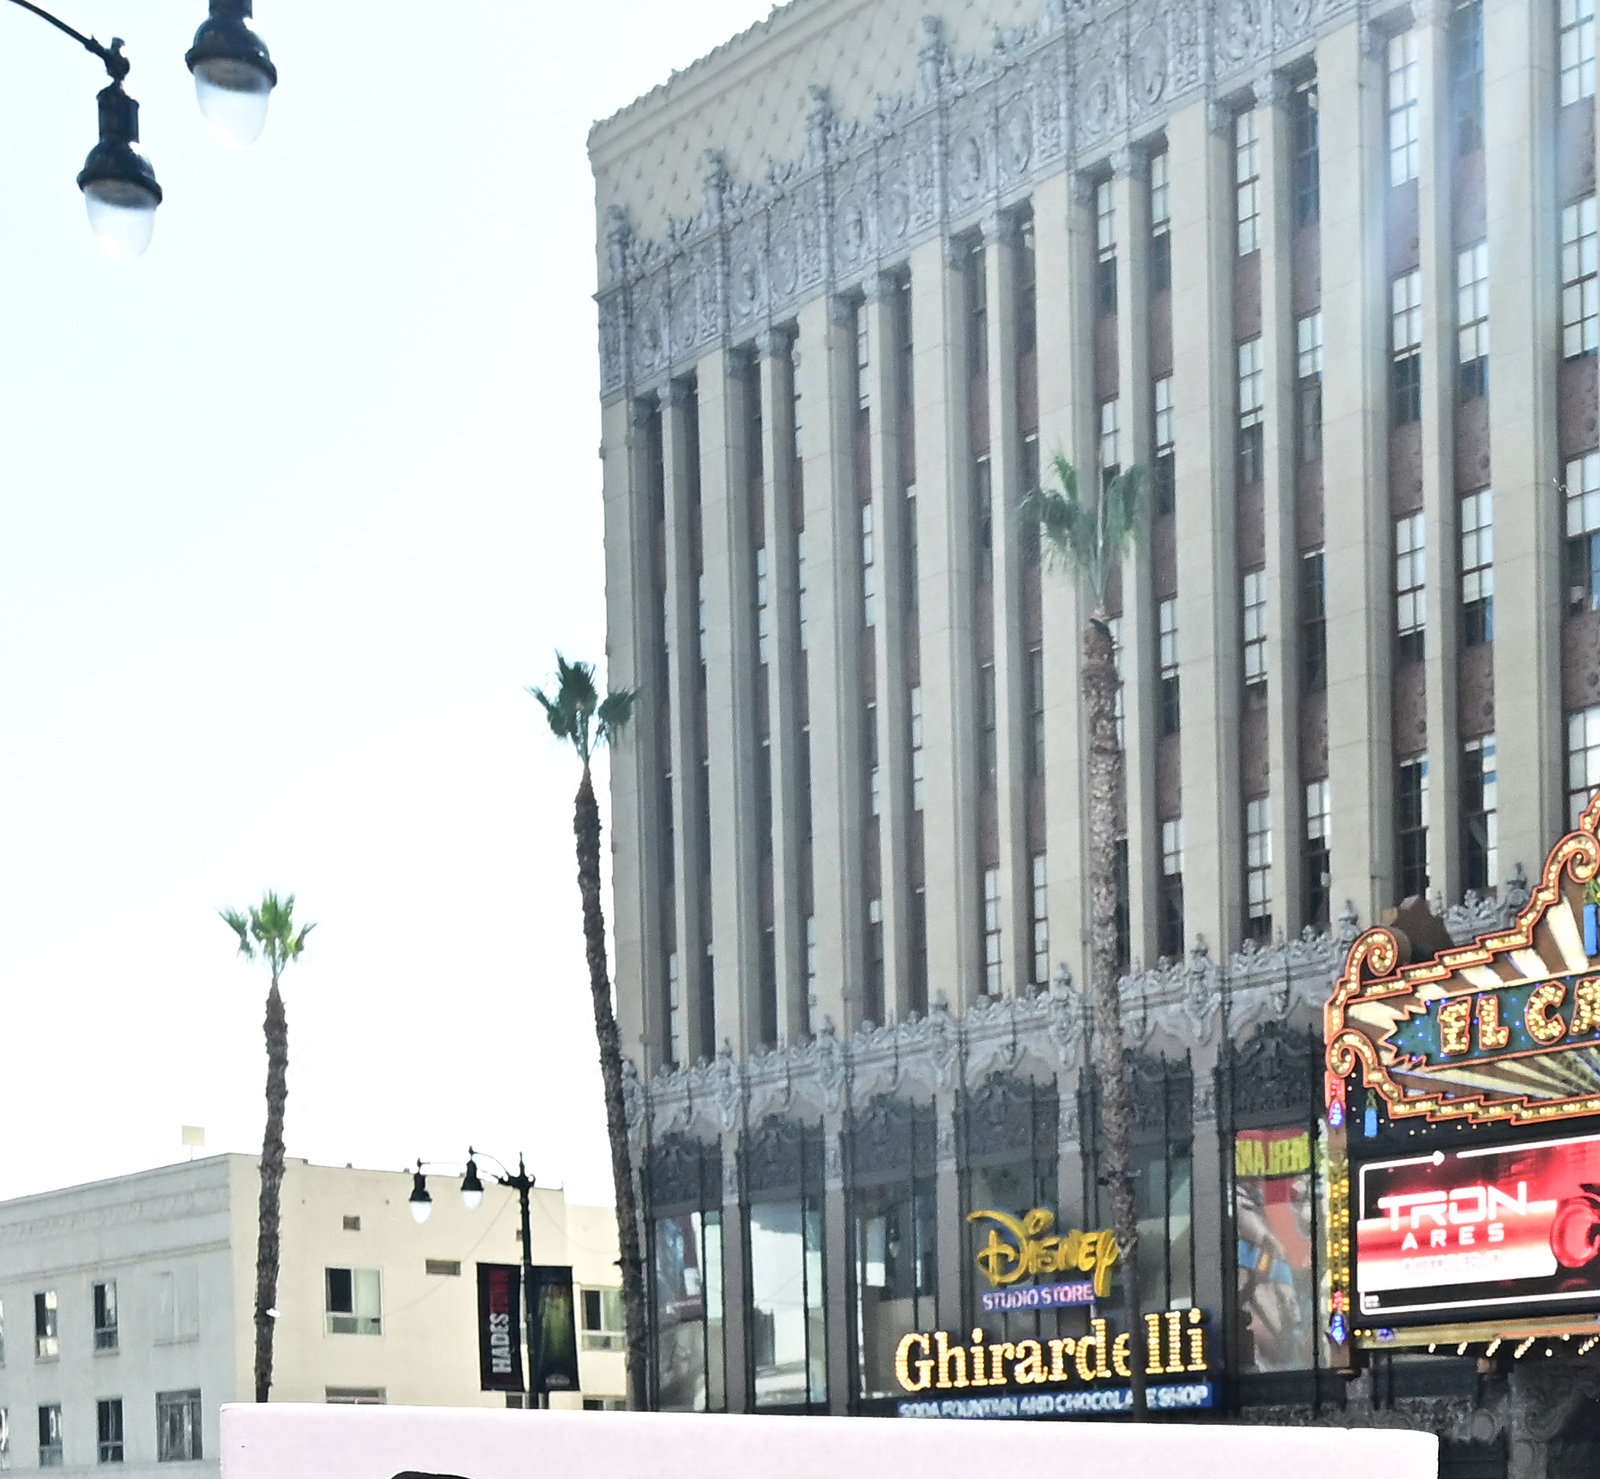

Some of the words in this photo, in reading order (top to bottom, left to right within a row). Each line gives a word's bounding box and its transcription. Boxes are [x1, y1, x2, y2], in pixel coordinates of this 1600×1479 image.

[1438, 992, 1510, 1055] EL
[1378, 1181, 1528, 1231] TRON
[967, 1208, 1119, 1297] Disney
[1401, 1223, 1505, 1251] ARES
[983, 1290, 1039, 1311] STUDIO
[1041, 1283, 1095, 1305] STORE
[895, 1307, 1208, 1392] Ghirardelli
[900, 1402, 940, 1417] SODA
[1020, 1395, 1054, 1414] AND
[1056, 1388, 1157, 1413] CHOCOLAE
[1158, 1385, 1208, 1407] SHOP
